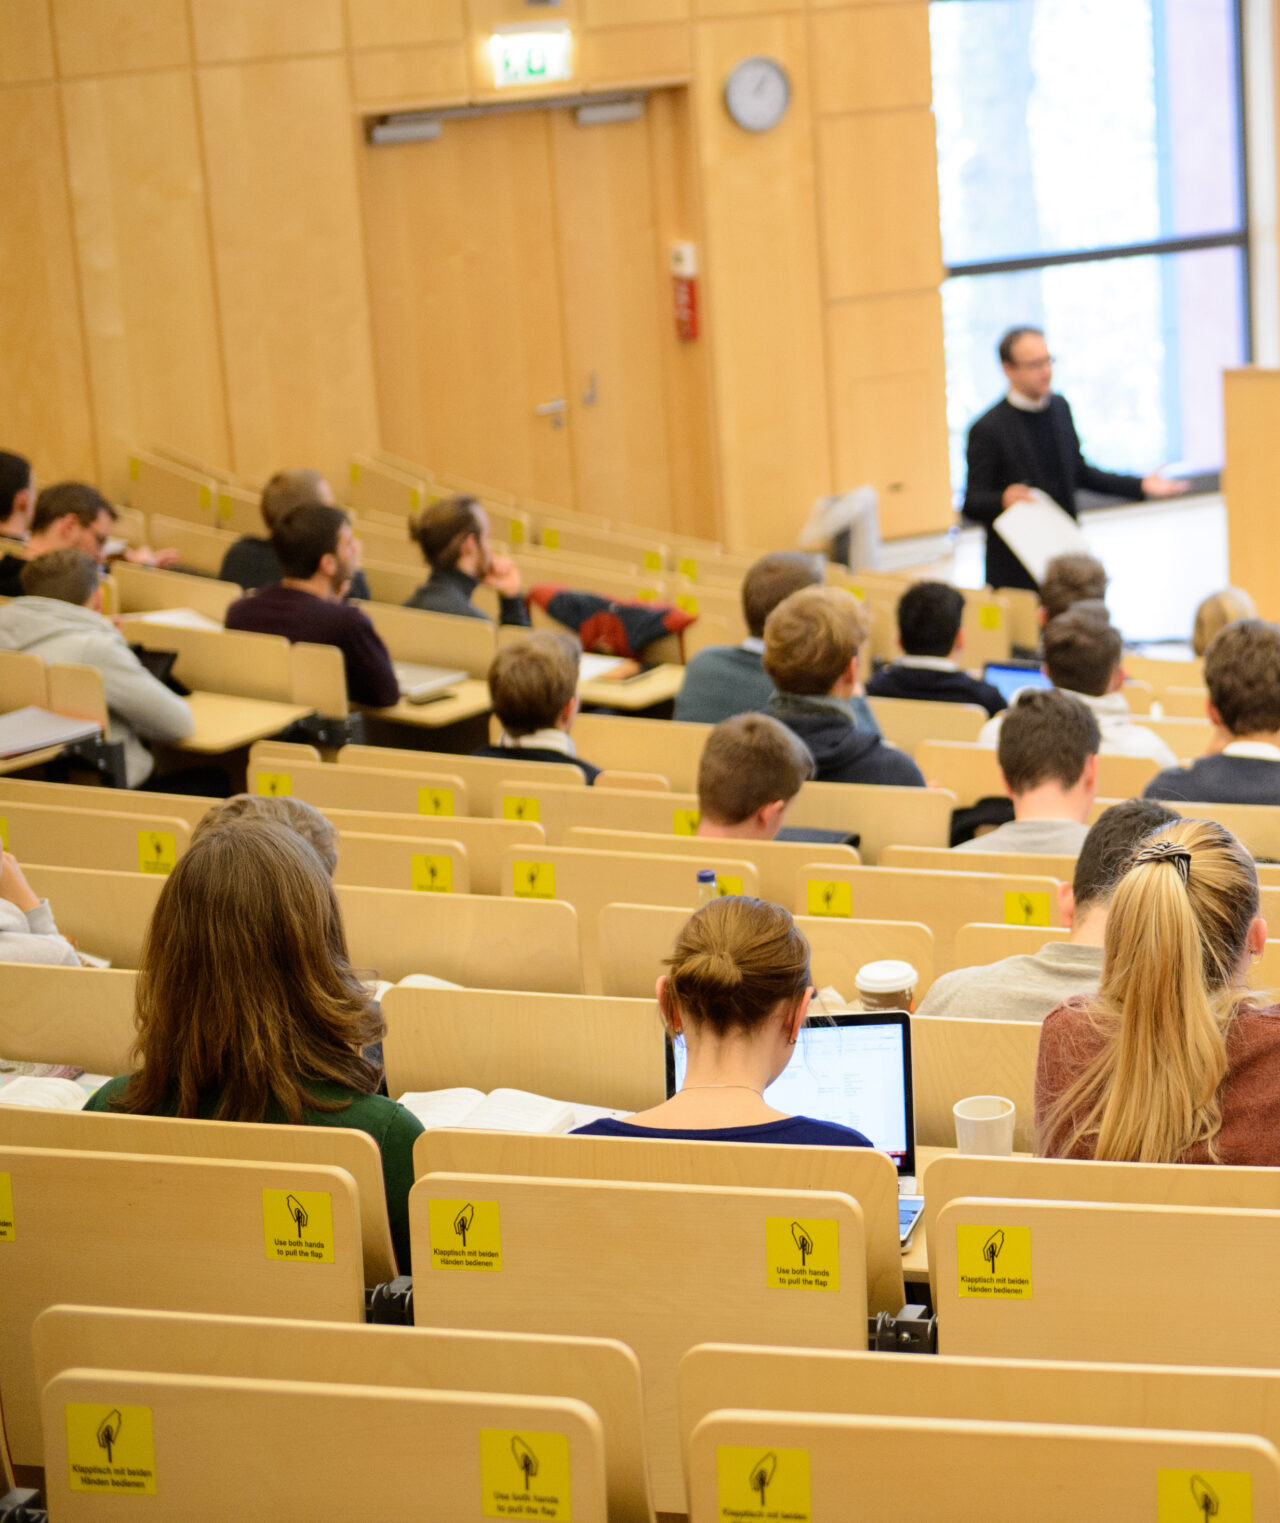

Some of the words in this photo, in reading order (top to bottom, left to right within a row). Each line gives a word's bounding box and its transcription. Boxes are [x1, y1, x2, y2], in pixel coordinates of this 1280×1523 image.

[274, 1238, 286, 1246] Use
[289, 1239, 303, 1247] both
[305, 1241, 324, 1249] hands
[285, 1249, 297, 1257] pull
[299, 1249, 309, 1257] the
[310, 1250, 323, 1259] flap
[433, 1248, 466, 1257] Klapptisch
[479, 1250, 499, 1258] beiden
[792, 1267, 806, 1275] both
[809, 1268, 829, 1276] hands
[788, 1278, 800, 1286] pull
[815, 1279, 828, 1287] flap
[961, 1276, 994, 1284] Klapptisch
